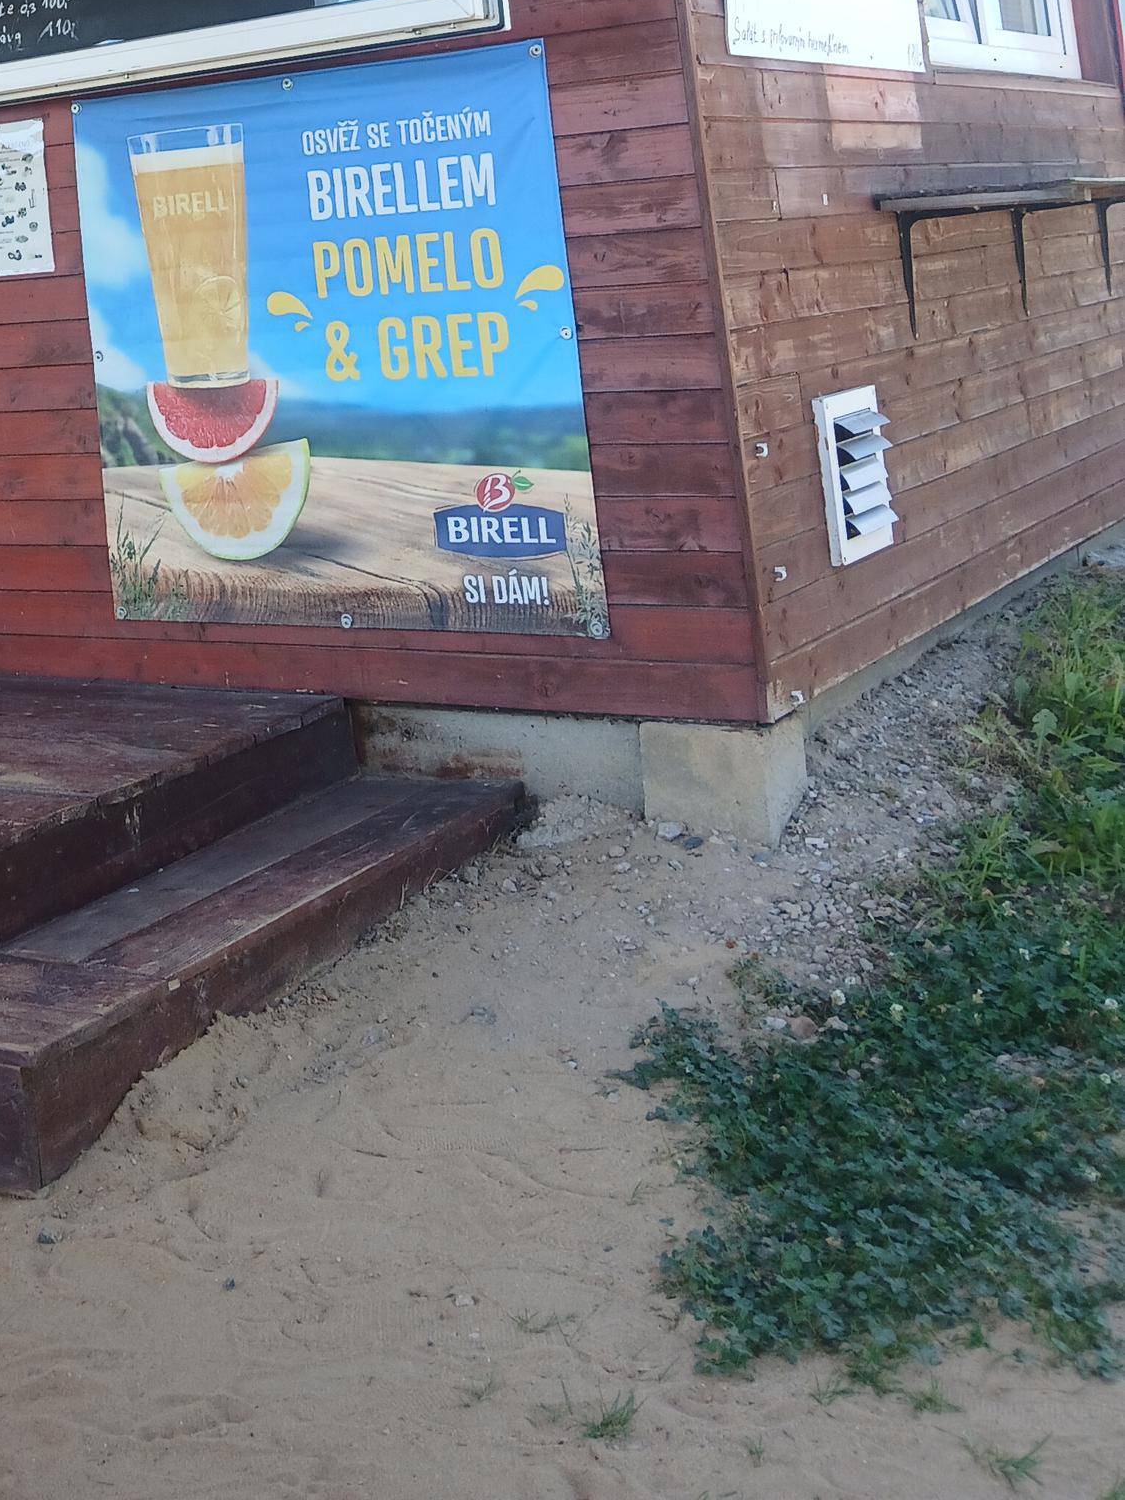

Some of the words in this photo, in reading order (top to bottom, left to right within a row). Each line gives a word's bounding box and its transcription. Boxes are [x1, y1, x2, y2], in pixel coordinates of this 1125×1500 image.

[302, 119, 361, 156] OSVĚŽ
[366, 122, 391, 149] SE
[396, 106, 491, 146] TOČENÝM
[153, 187, 229, 220] BIRELL
[307, 152, 496, 221] BIRELLEM
[312, 228, 504, 299] POMELO
[326, 320, 360, 382] &
[377, 311, 509, 380] GREP
[447, 516, 557, 544] BIRELL
[463, 574, 486, 604] SI
[491, 568, 550, 605] DÁM!
